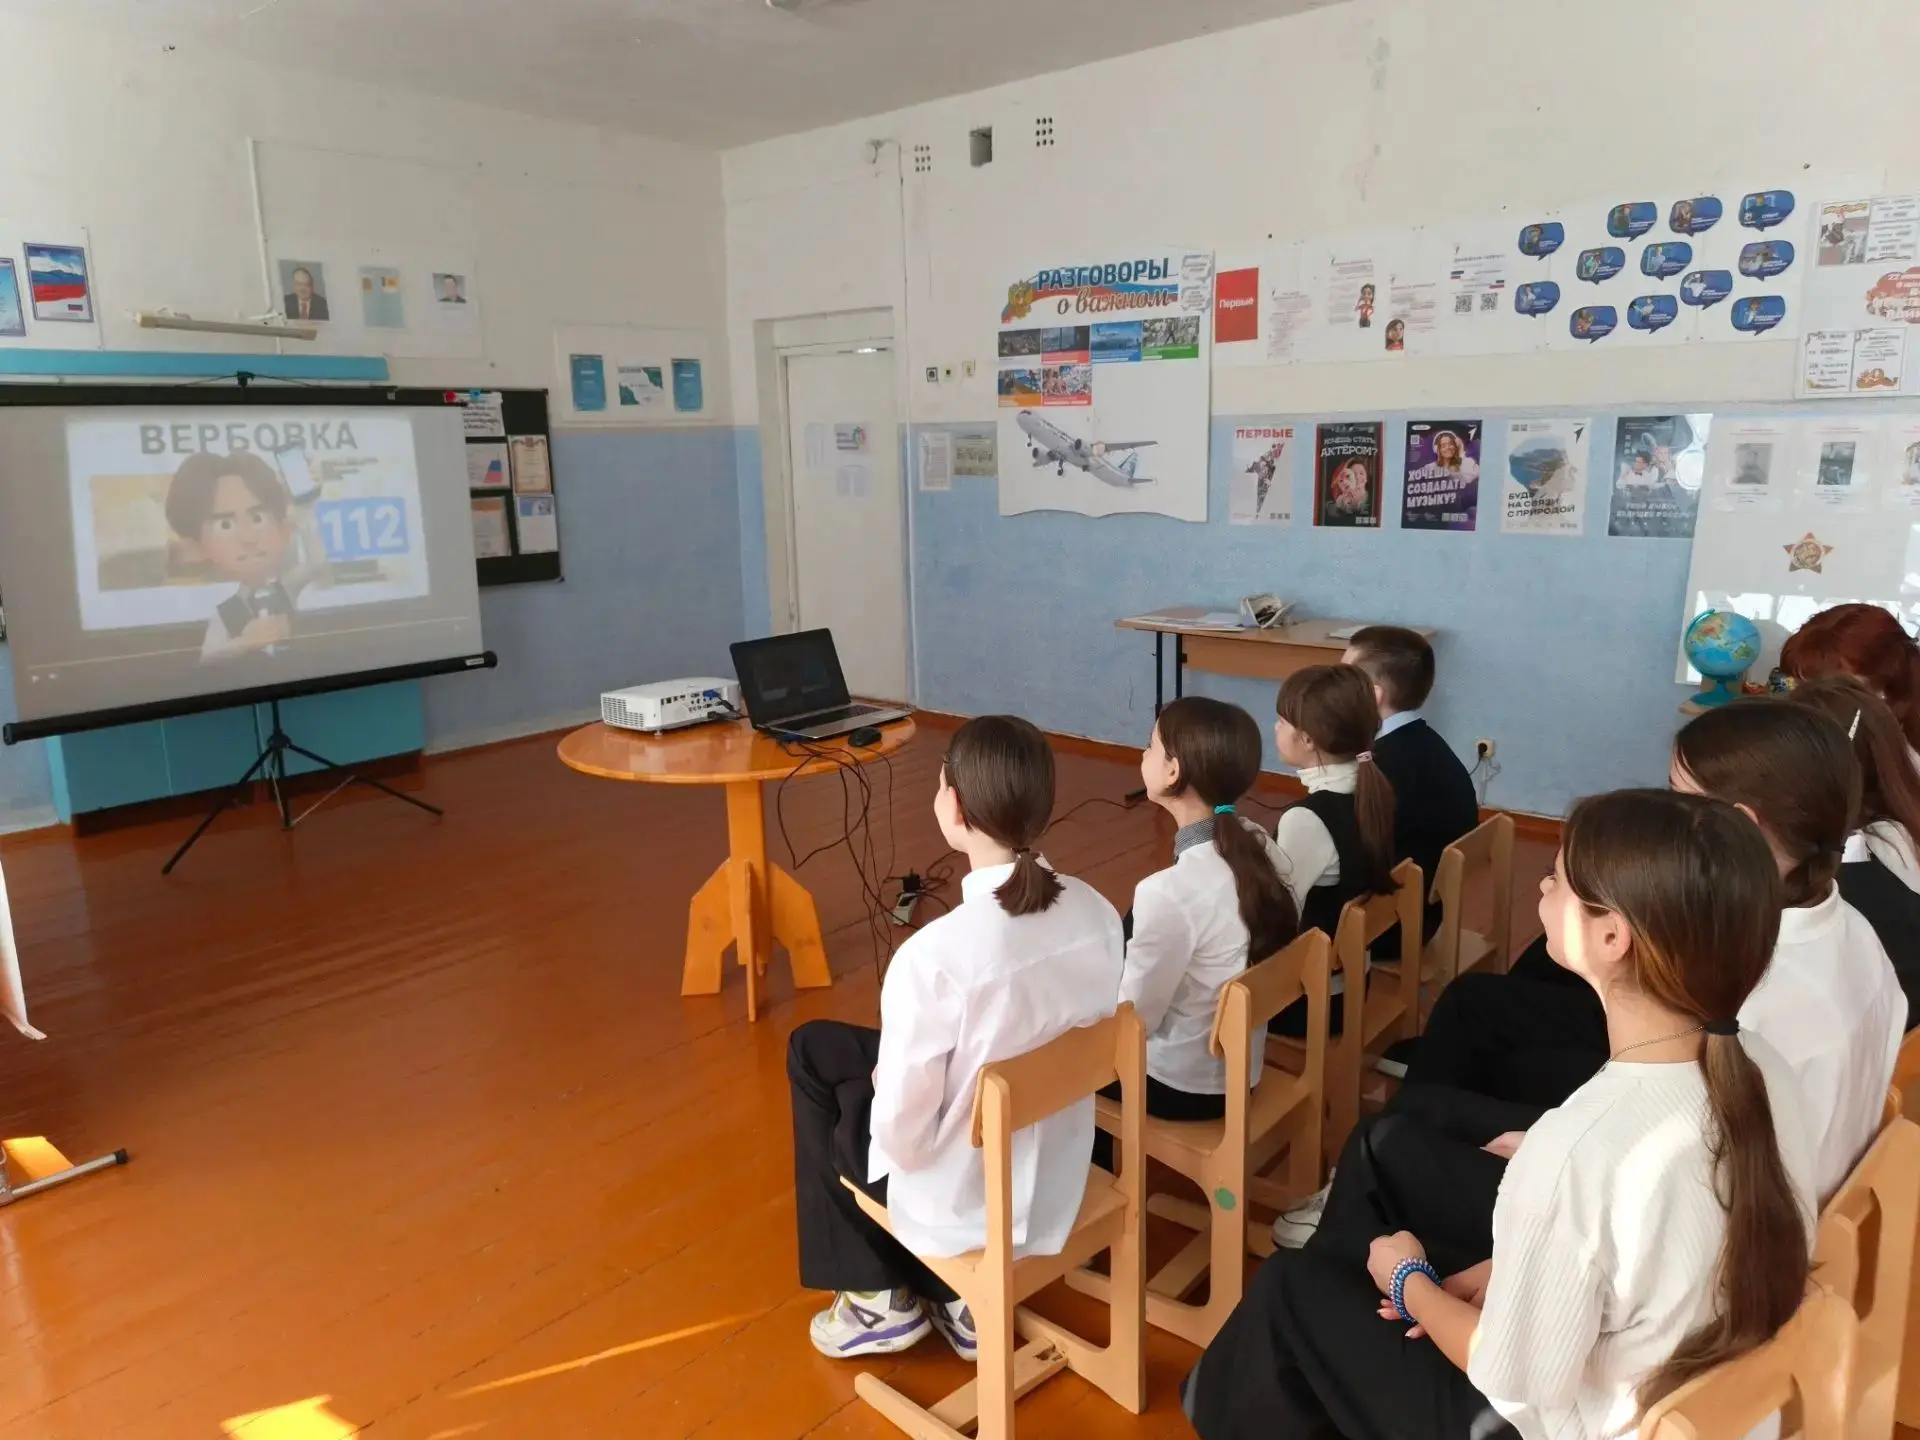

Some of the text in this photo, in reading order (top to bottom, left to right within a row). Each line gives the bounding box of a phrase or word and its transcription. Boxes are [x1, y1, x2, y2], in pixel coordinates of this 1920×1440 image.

[1038, 258, 1169, 291] РАЗГОВОРЫ
[1057, 297, 1070, 315] о
[1076, 286, 1170, 314] важном
[1219, 296, 1254, 311] Первые
[139, 421, 358, 455] ВЕРБОВКА
[1236, 428, 1294, 439] ПЕРВЫЕ
[1321, 444, 1378, 457] АКТЁРОМ?
[1408, 467, 1449, 481] ХОЧЕШЬ
[1407, 479, 1466, 494] СОЗДАВАТЬ
[1407, 493, 1457, 508] МУЗЫКУ?
[1508, 498, 1560, 509] НА СВЯЗИ
[1515, 504, 1576, 518] ПРИРОДОЙ
[321, 503, 404, 551] 112
